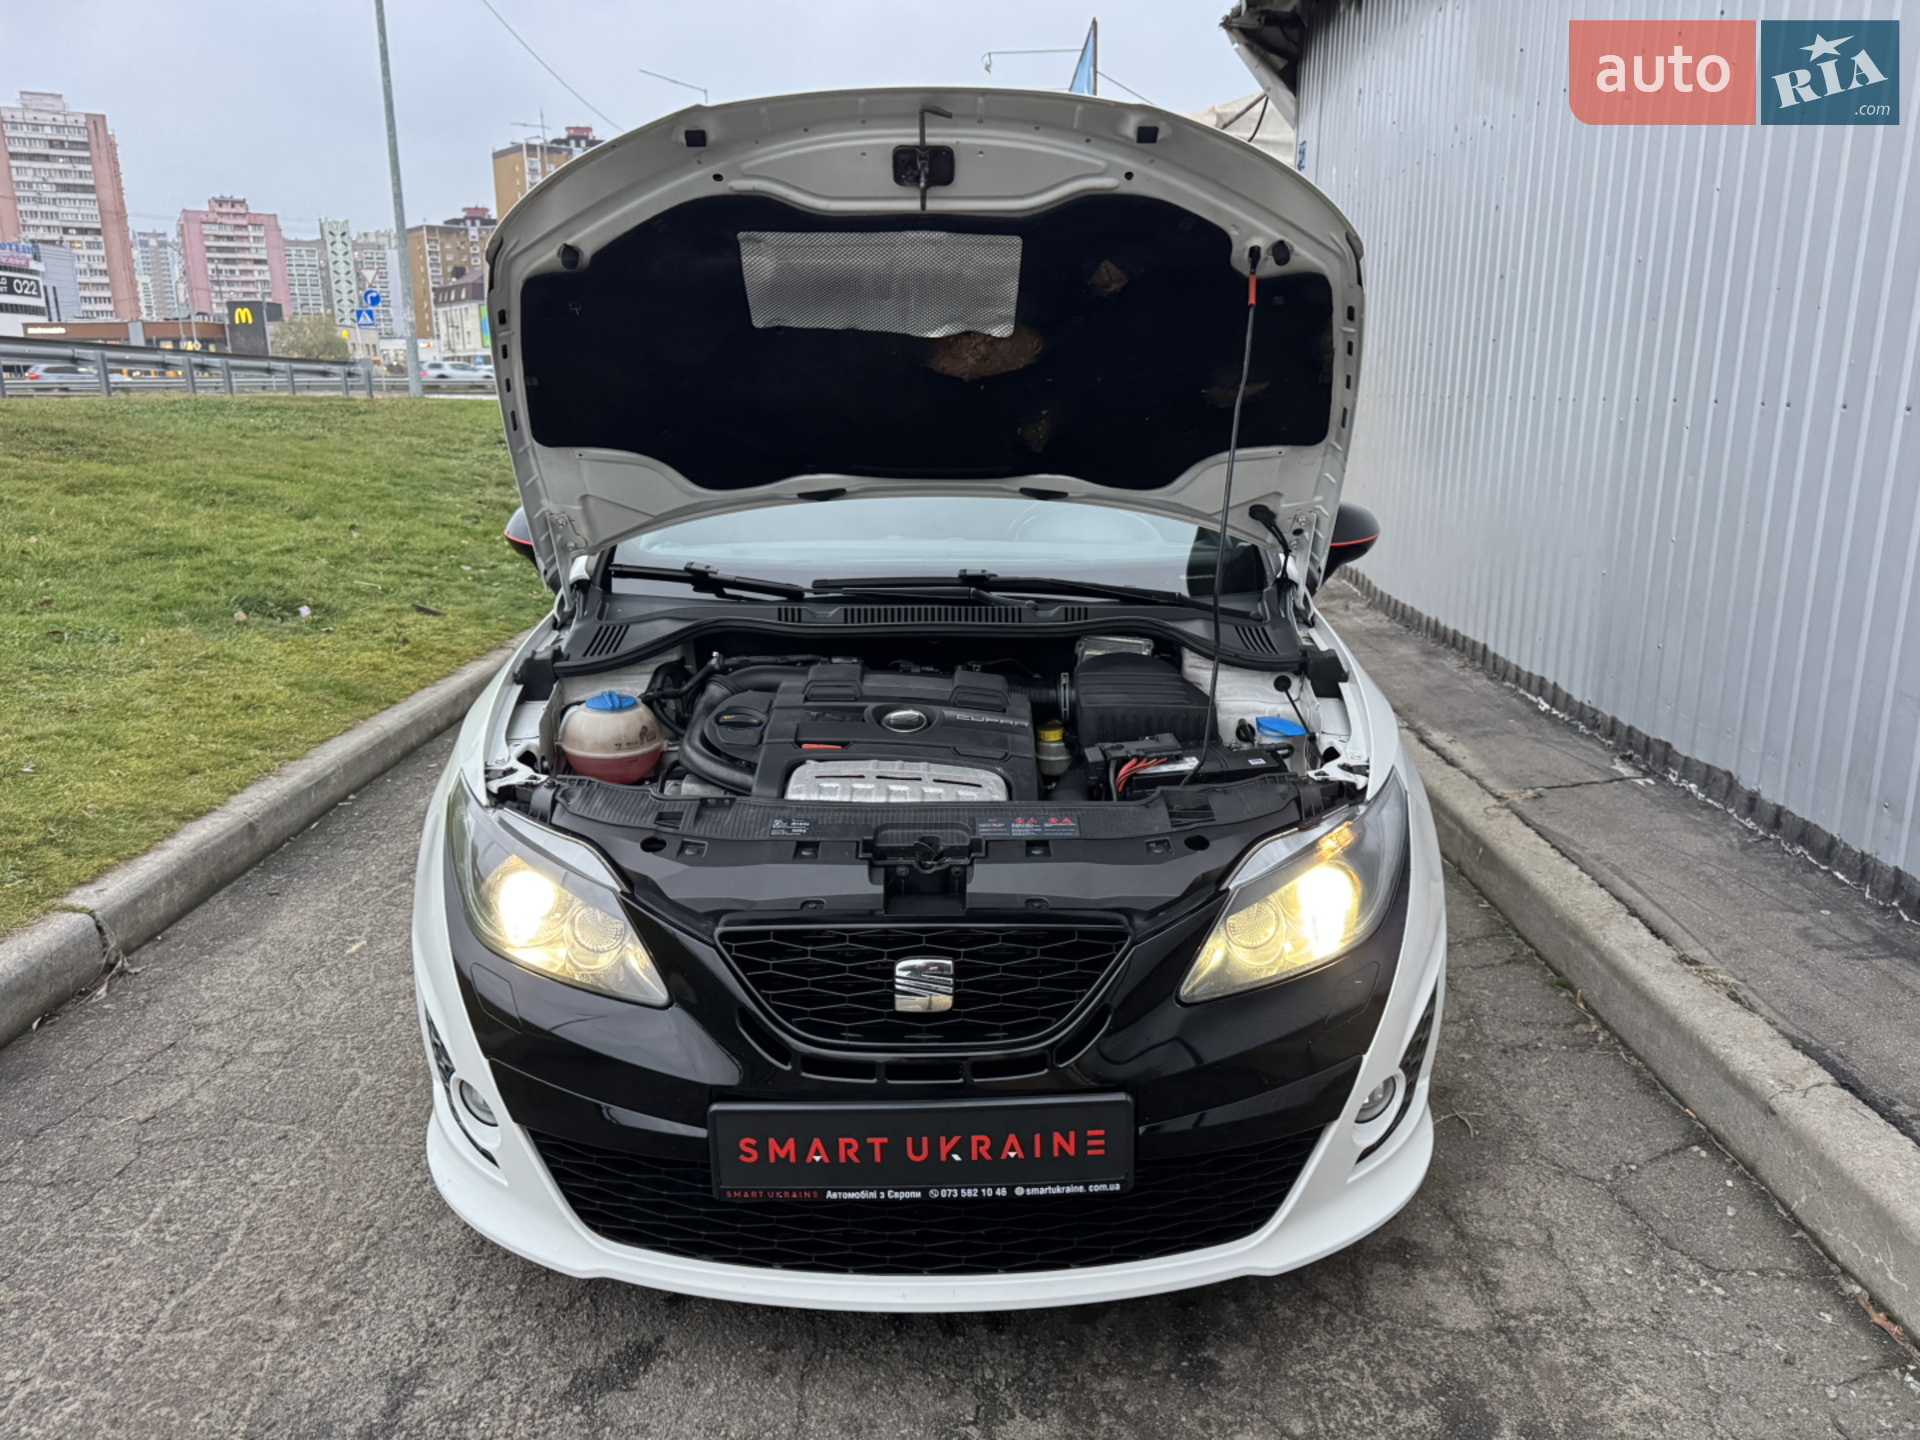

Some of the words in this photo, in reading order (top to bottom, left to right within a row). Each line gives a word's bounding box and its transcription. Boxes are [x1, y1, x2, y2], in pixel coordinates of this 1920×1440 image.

[13, 278, 38, 295] 022
[738, 1137, 889, 1163] SMART
[906, 1130, 1106, 1162] UKRAINE
[726, 1190, 764, 1198] SMART
[768, 1190, 819, 1198] UKRAINE
[825, 1189, 877, 1199] Автомобілі
[879, 1191, 885, 1199] з
[887, 1189, 922, 1200] Європи
[940, 1188, 958, 1198] 073
[961, 1188, 978, 1197] 582
[981, 1187, 993, 1197] 10
